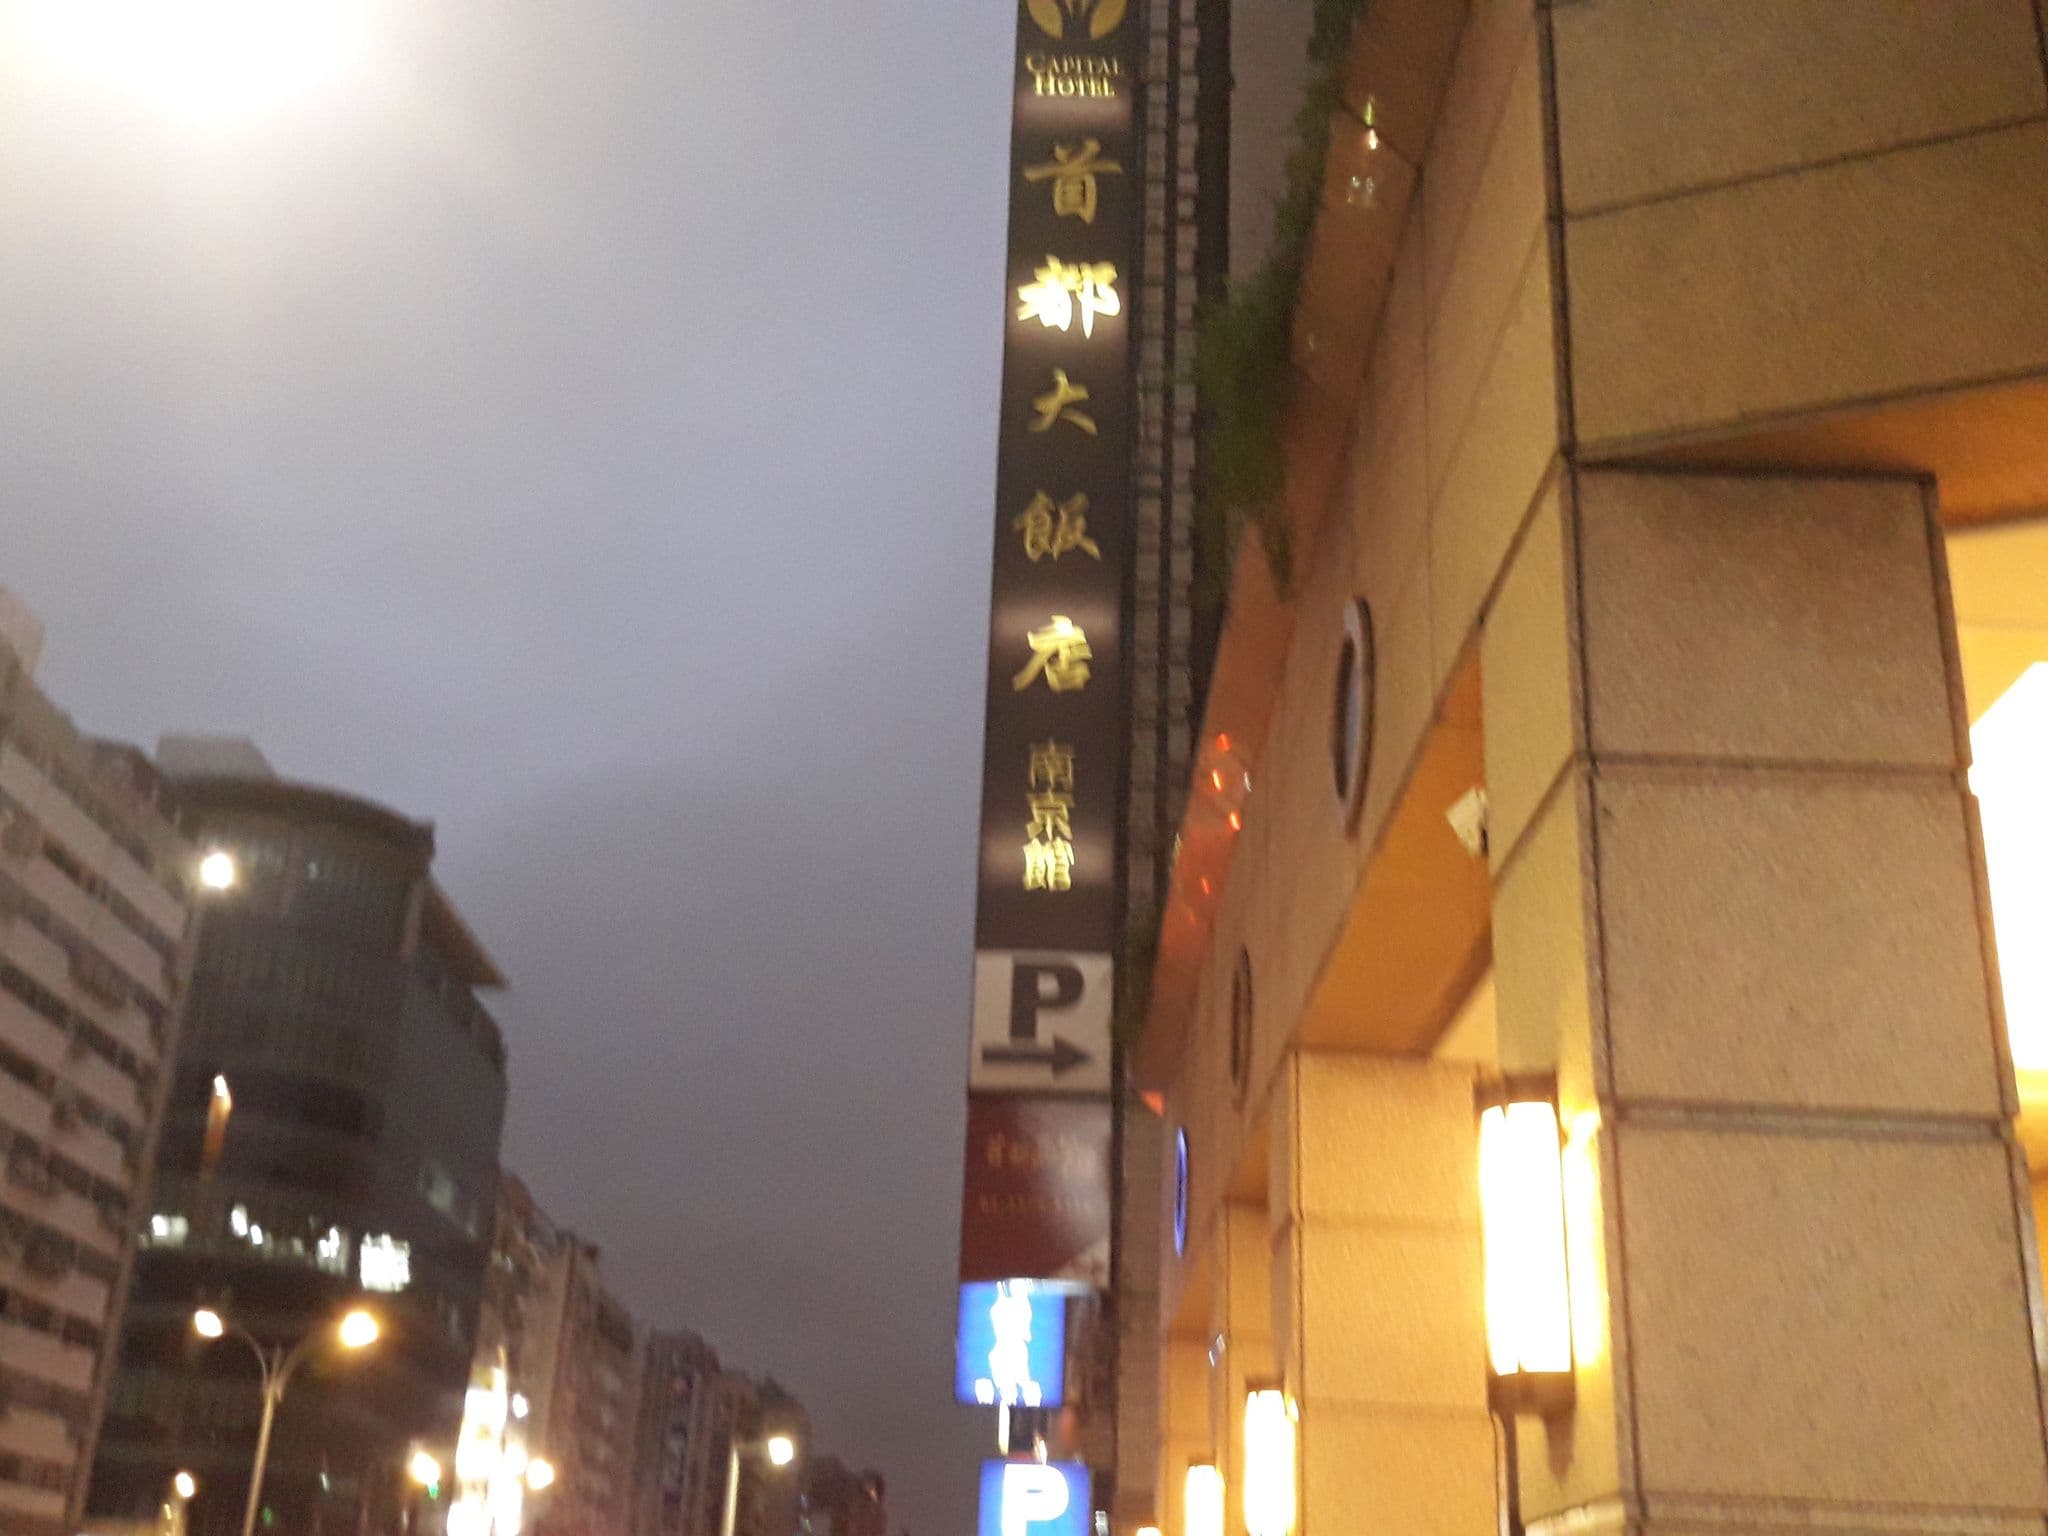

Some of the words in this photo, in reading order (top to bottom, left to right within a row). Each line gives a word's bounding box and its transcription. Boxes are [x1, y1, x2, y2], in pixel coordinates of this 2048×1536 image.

[1012, 139, 1122, 692] 首都大飯店
[1010, 960, 1084, 1038] P
[1002, 1463, 1069, 1536] P
